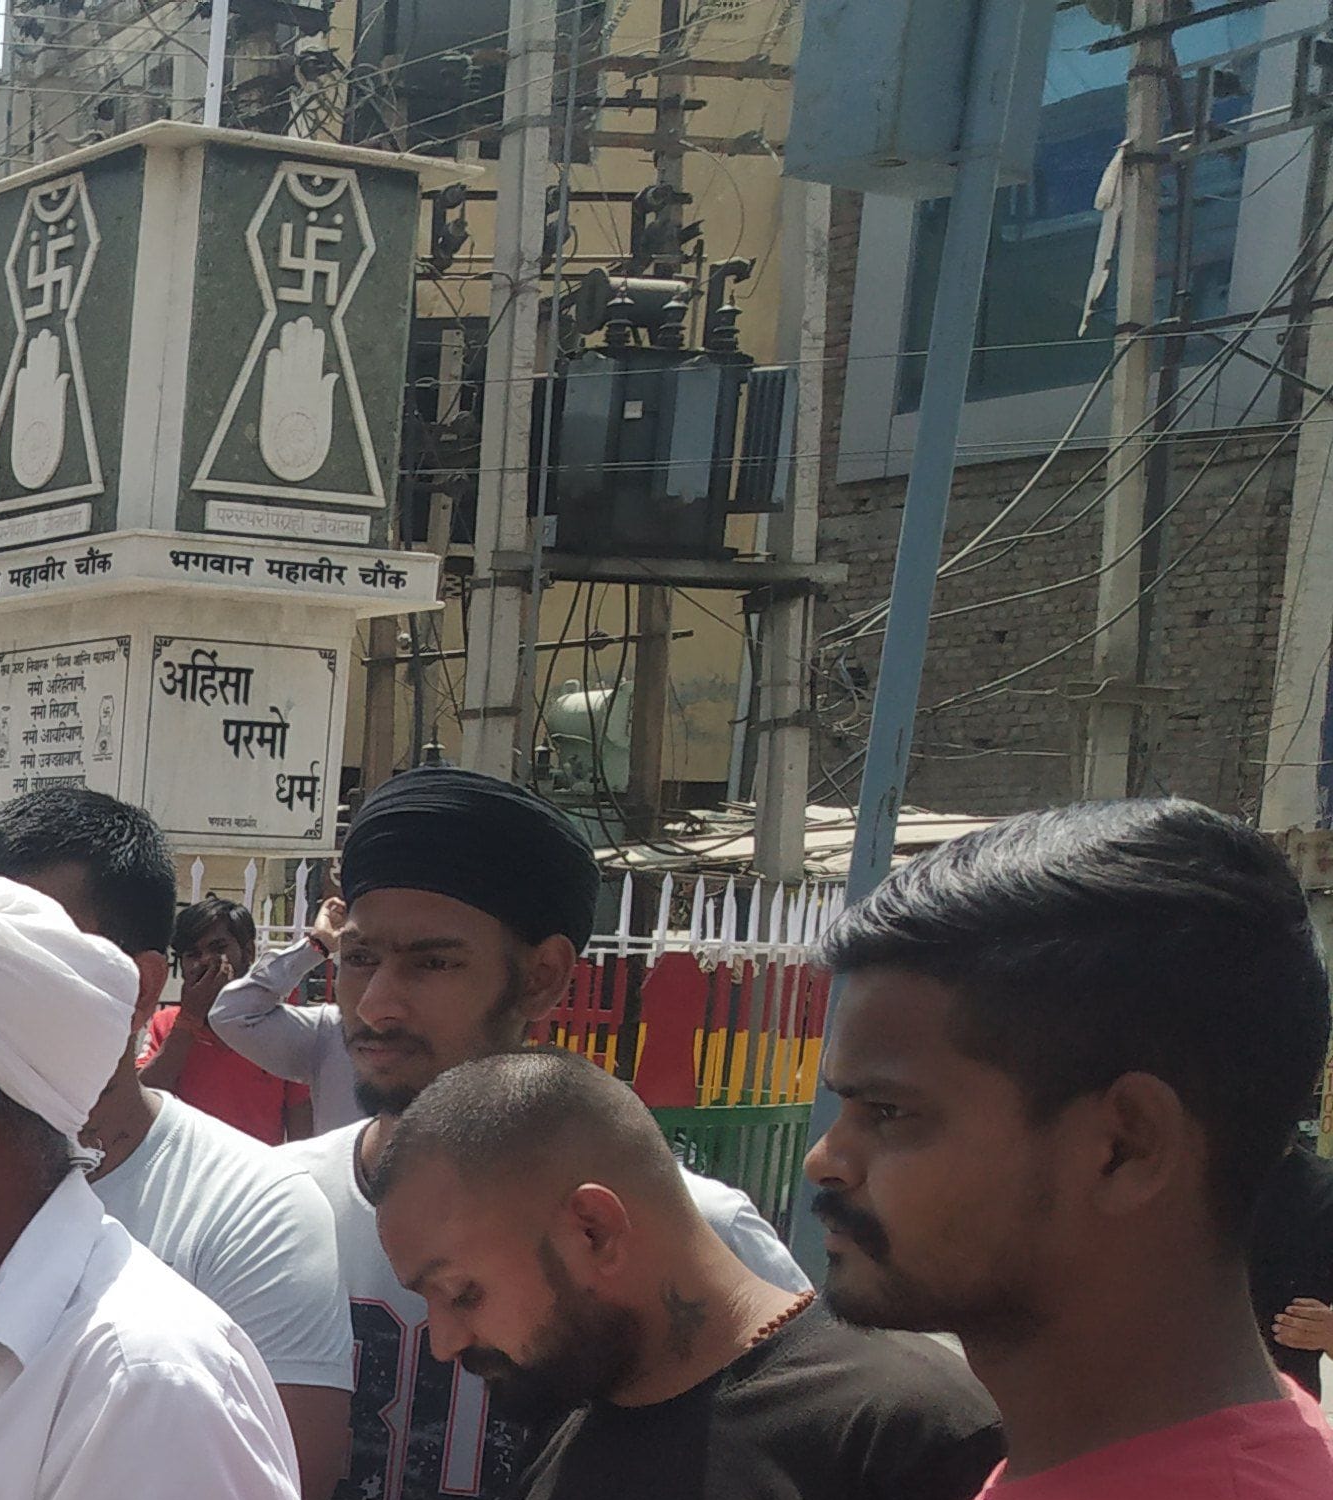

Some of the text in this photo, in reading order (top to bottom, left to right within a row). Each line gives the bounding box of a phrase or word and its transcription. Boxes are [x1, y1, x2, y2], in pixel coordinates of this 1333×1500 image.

[8, 555, 67, 588] महावीर
[74, 546, 113, 576] चौंक
[169, 549, 409, 589] भगवान महावीर चौंक
[27, 675, 43, 697] नमो
[160, 648, 255, 707] अहिंसा
[30, 699, 46, 720] नमो
[22, 724, 38, 746] नमो
[223, 705, 290, 760] परमो
[20, 748, 36, 769] नमो
